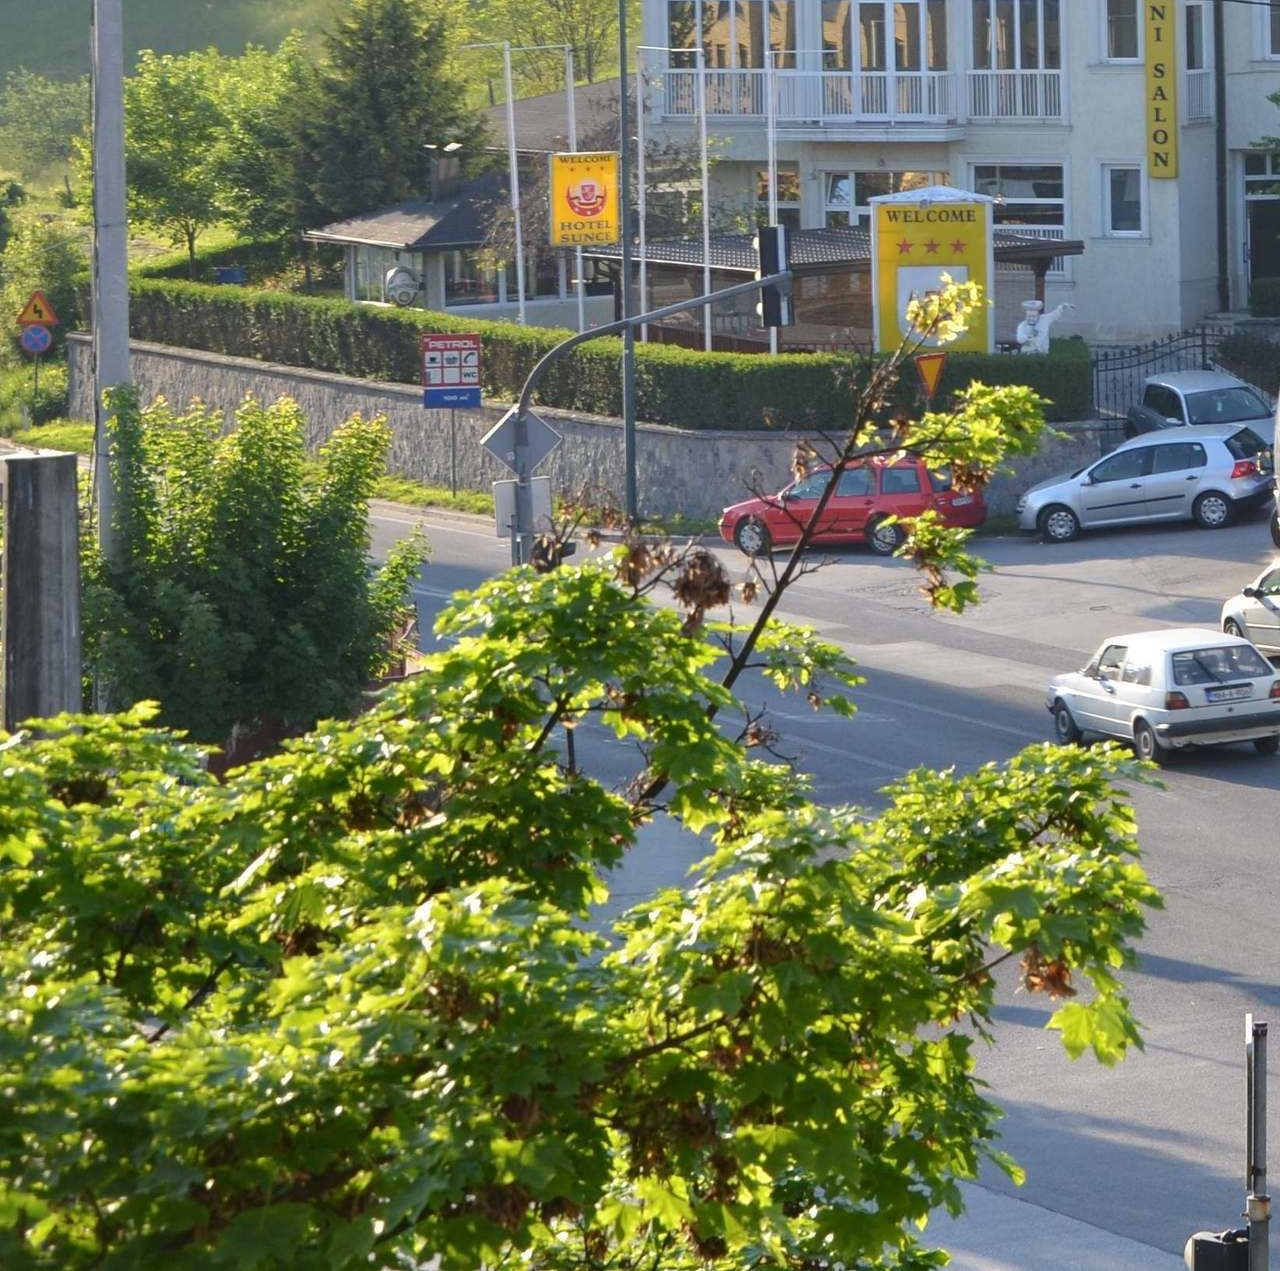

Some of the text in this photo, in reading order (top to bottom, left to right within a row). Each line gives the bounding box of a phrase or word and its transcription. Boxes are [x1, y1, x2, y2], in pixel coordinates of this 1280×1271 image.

[1152, 63, 1169, 168] SALON
[560, 155, 612, 164] WELCOME
[886, 210, 977, 223] WELCOME
[560, 220, 613, 231] HOTEL
[561, 232, 612, 243] SUNCE
[428, 340, 478, 349] PETROL
